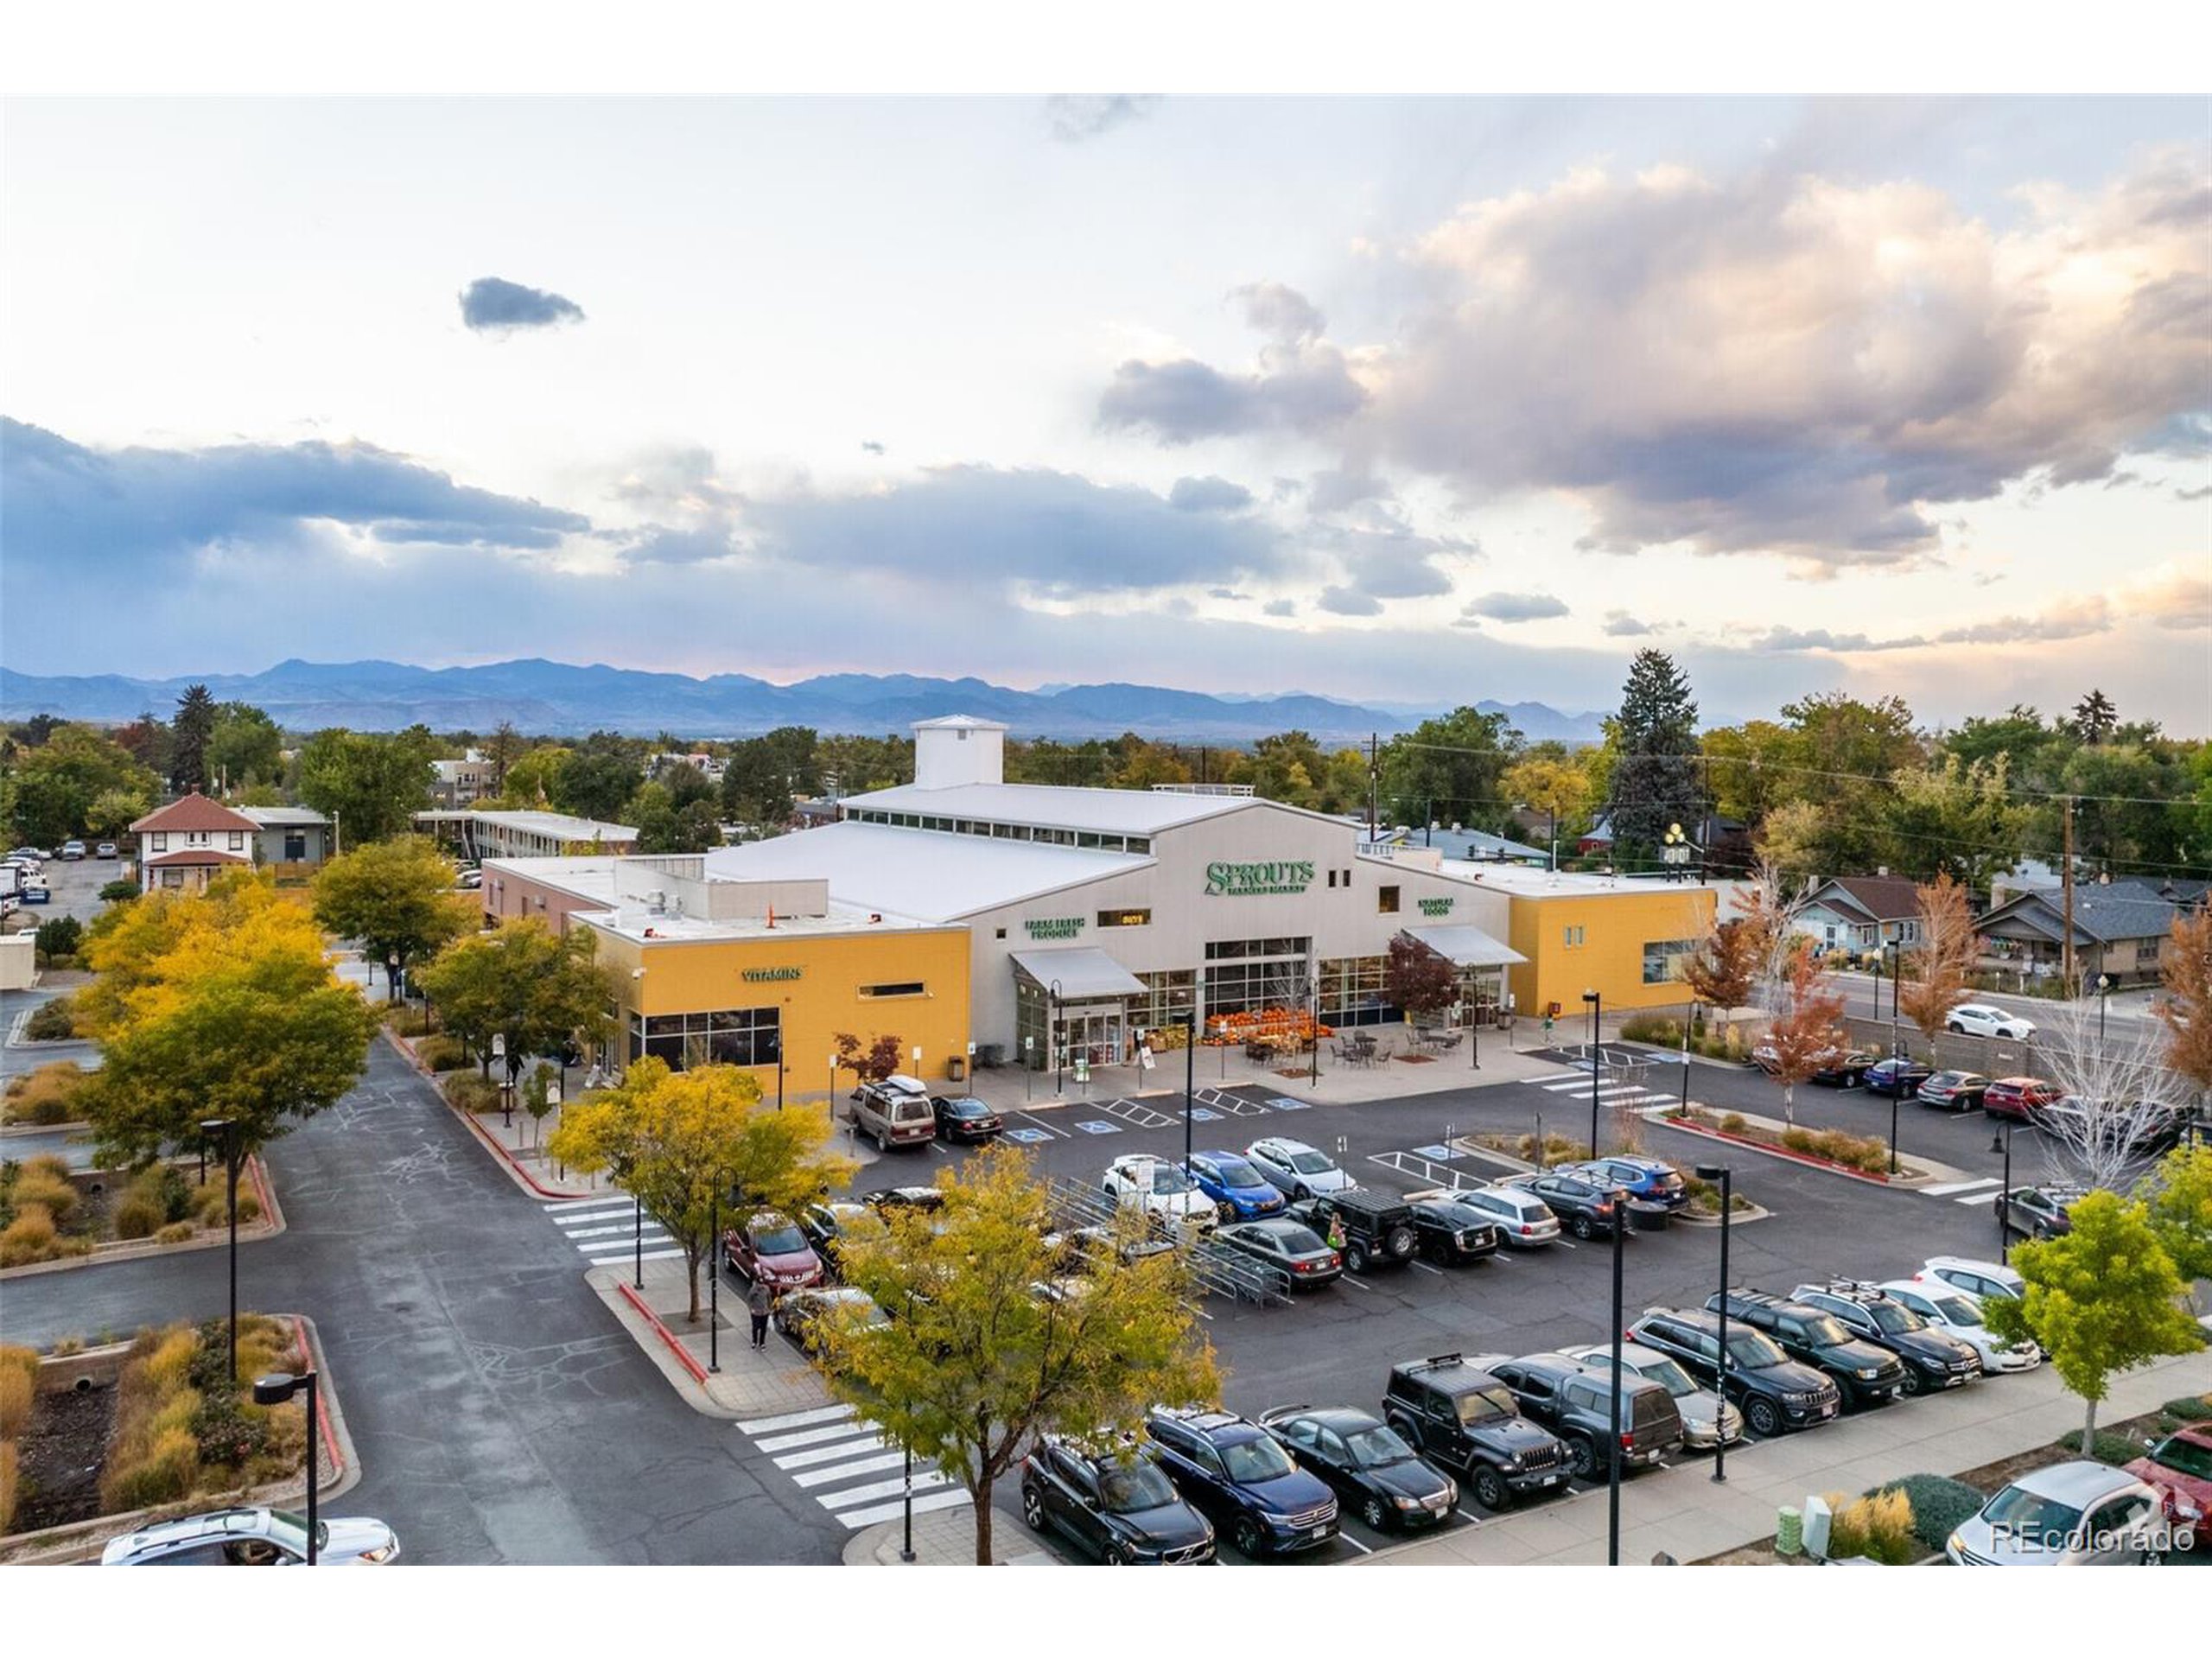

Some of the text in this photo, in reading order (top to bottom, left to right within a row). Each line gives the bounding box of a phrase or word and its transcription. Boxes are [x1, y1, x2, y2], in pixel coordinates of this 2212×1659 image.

[1205, 861, 1314, 895] SPROUTS
[1032, 929, 1077, 939] PRODUCE
[741, 968, 802, 982] VITAMINS
